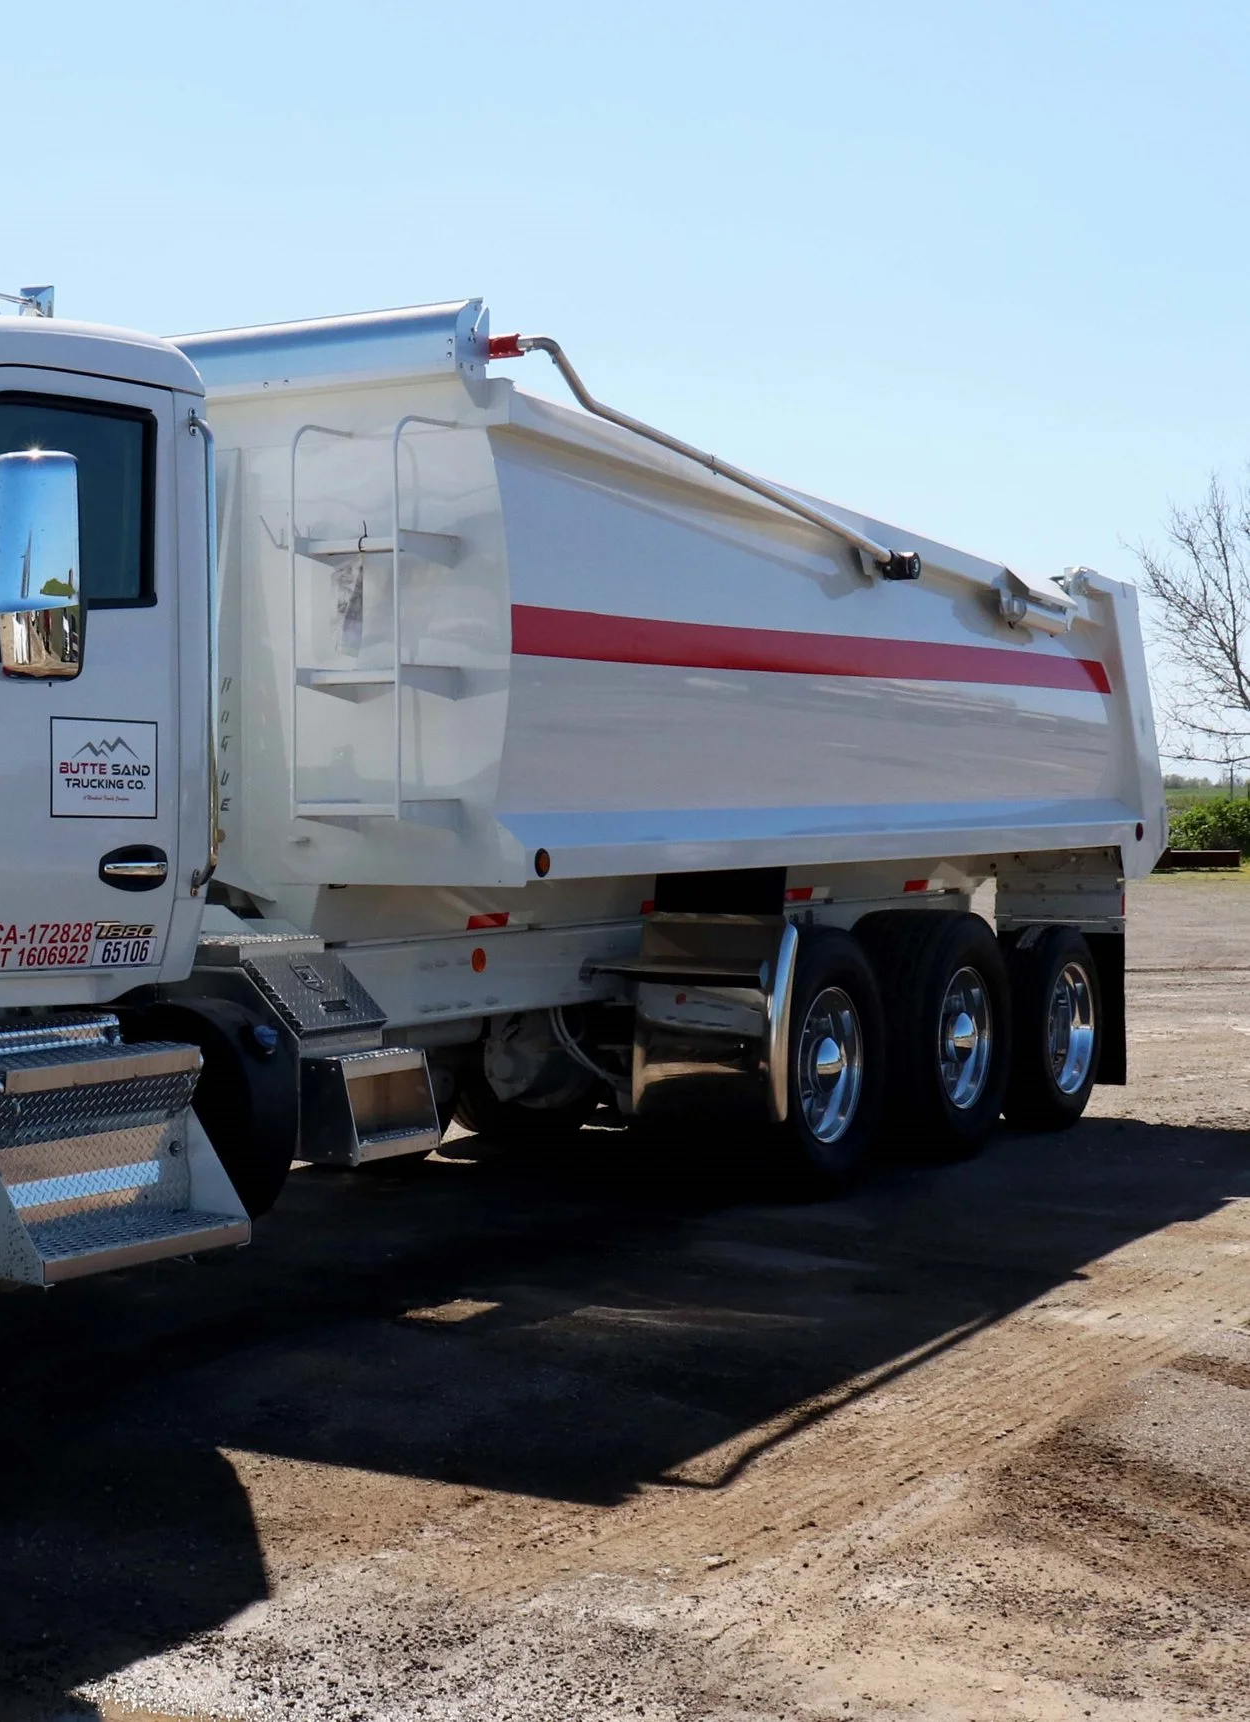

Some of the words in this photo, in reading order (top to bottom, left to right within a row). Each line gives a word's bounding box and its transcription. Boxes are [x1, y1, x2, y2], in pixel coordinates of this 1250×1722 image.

[59, 762, 107, 775] BUTTE
[111, 764, 151, 776] SAND
[65, 778, 124, 789] TRUCKING
[127, 780, 146, 790] CO.
[95, 921, 157, 939] T880
[18, 945, 88, 967] 1606922
[102, 940, 150, 964] 65106
